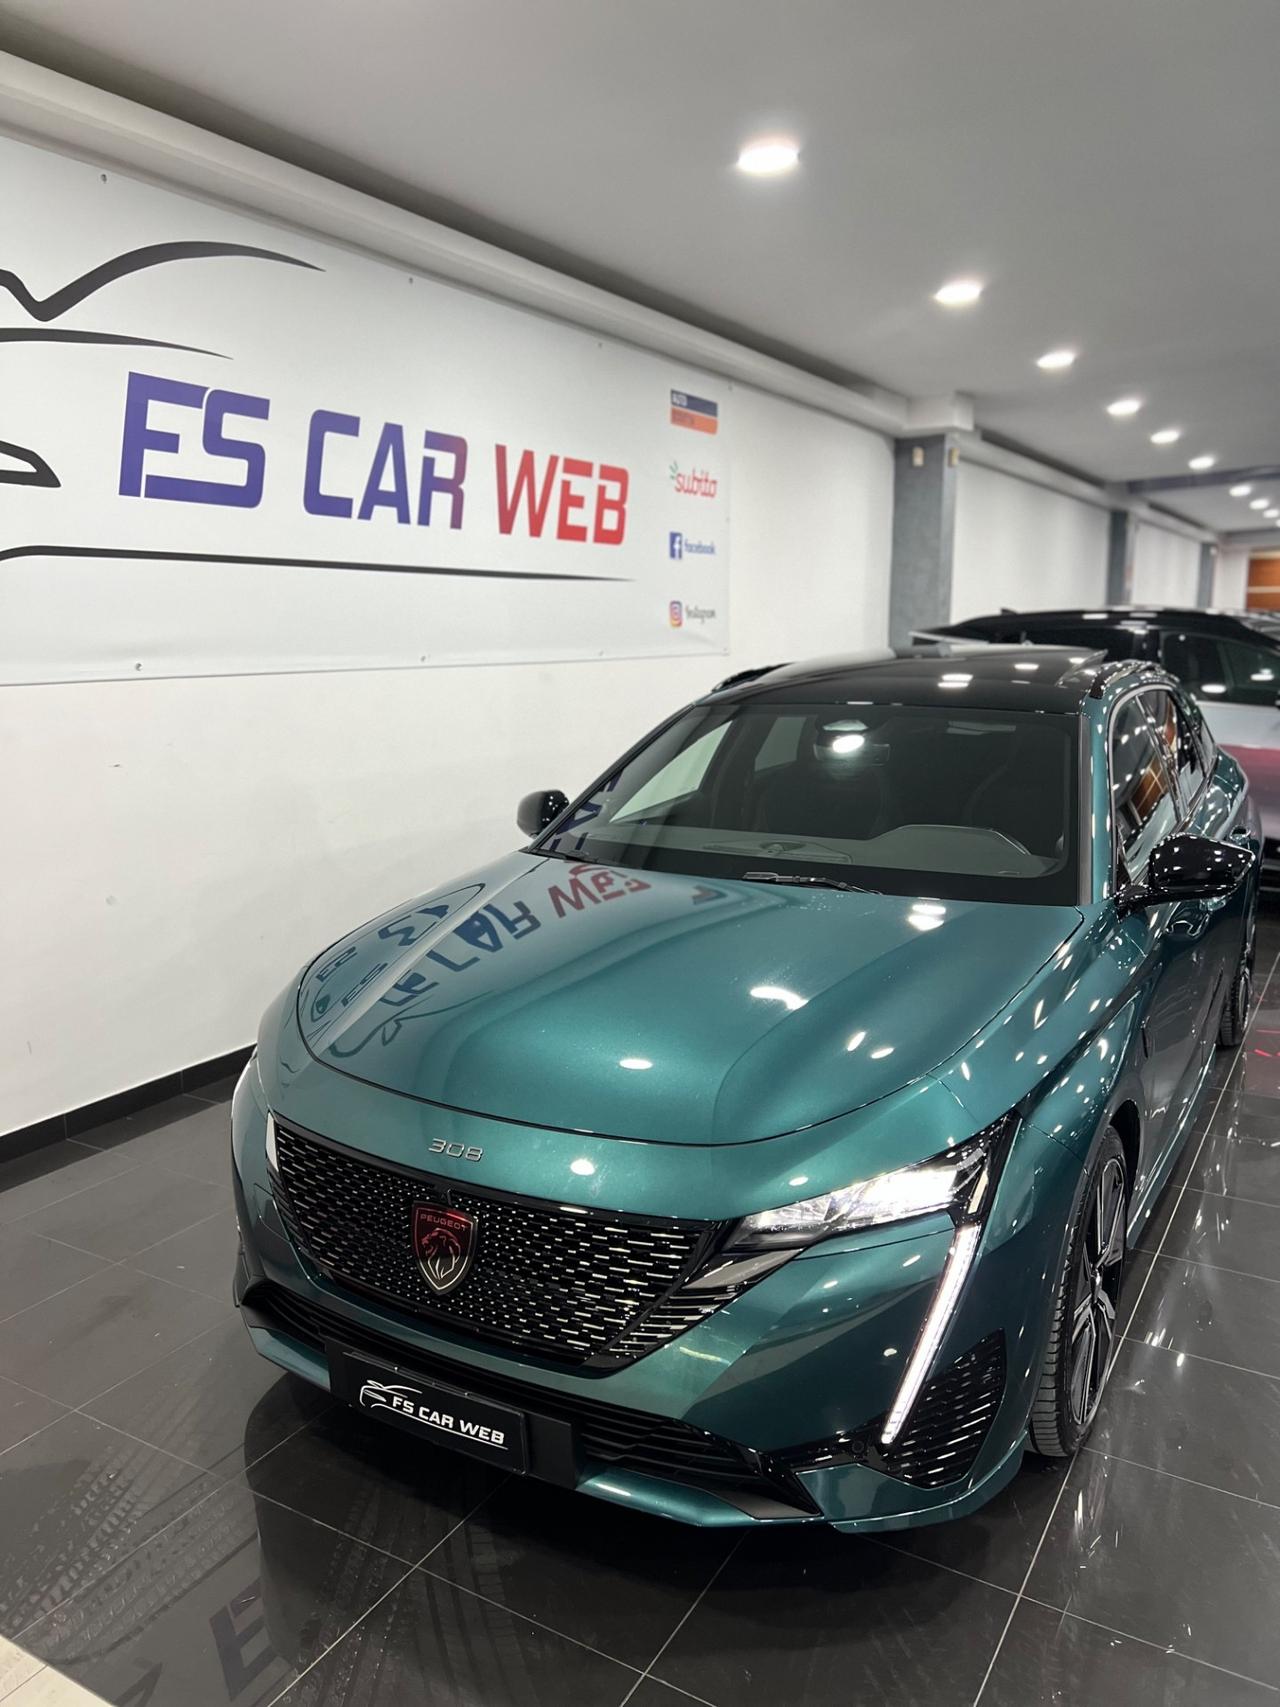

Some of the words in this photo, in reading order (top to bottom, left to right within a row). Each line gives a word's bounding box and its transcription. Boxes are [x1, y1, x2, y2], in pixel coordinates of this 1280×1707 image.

[118, 371, 270, 509] FS
[303, 409, 468, 530] CAR
[495, 444, 629, 546] WEB
[428, 1138, 483, 1161] 308
[420, 1213, 468, 1231] PEUGEOT
[392, 1396, 414, 1413] FS
[418, 1406, 454, 1429] CAR
[459, 1419, 505, 1445] WEB
